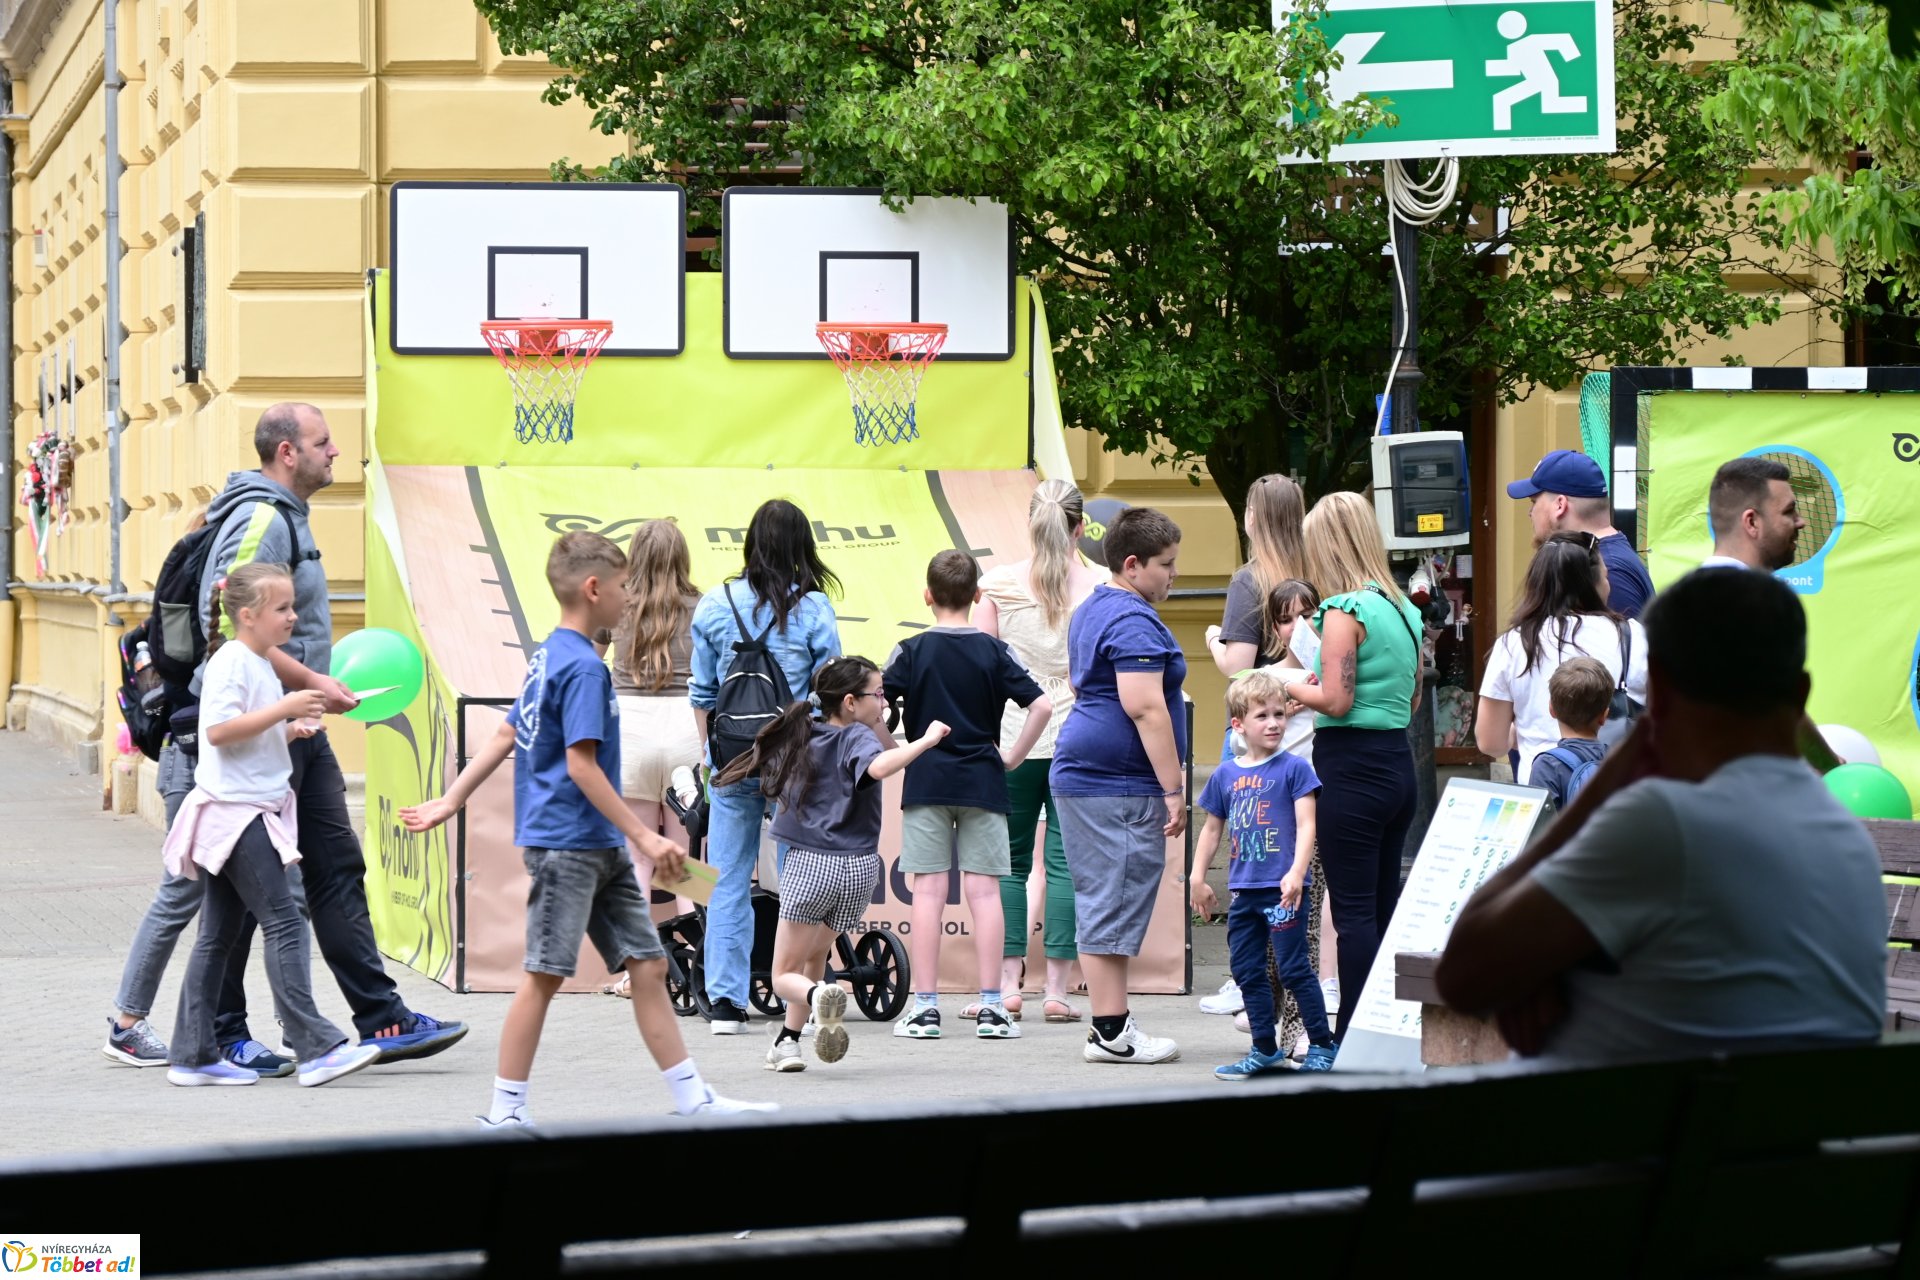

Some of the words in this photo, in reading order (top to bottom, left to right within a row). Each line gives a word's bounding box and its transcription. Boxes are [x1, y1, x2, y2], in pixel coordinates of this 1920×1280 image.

[704, 520, 896, 543] mhu
[844, 540, 900, 549] GROUP
[1233, 775, 1262, 792] SMALL
